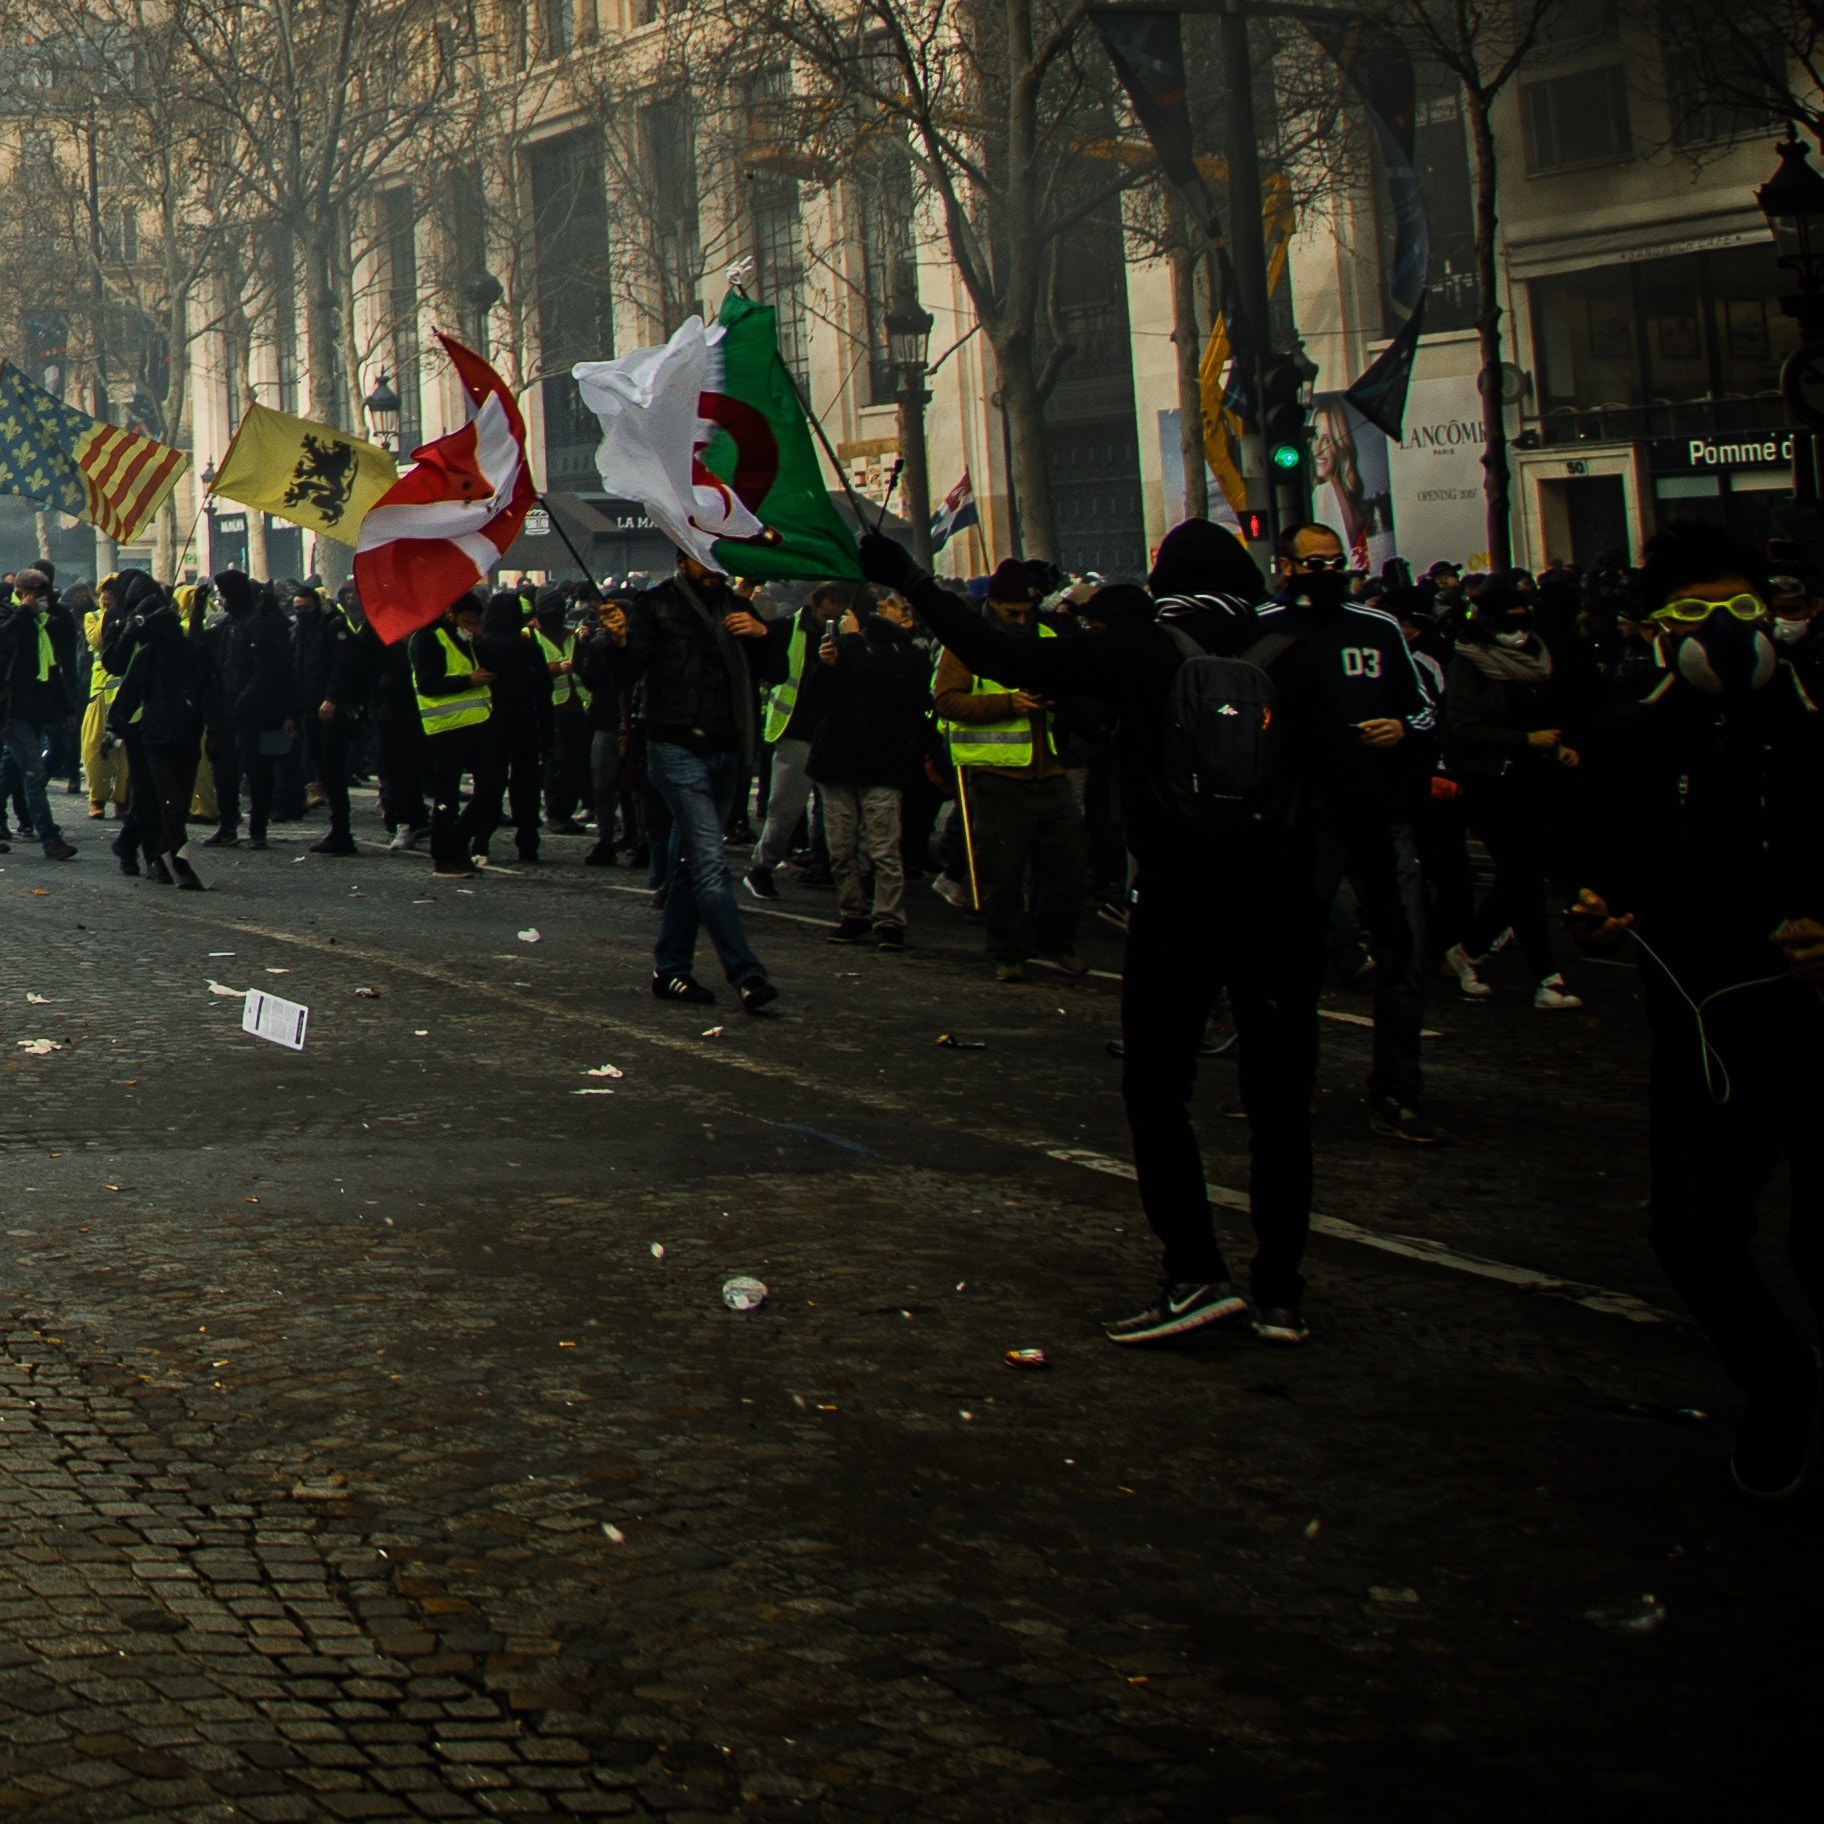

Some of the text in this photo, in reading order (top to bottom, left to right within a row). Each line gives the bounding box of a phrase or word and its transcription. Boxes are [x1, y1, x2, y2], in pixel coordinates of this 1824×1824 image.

[1688, 440, 1777, 466] Pomme
[1567, 462, 1585, 474] 50
[1417, 490, 1457, 502] OPENING
[616, 517, 635, 529] LA
[1341, 646, 1382, 678] 03
